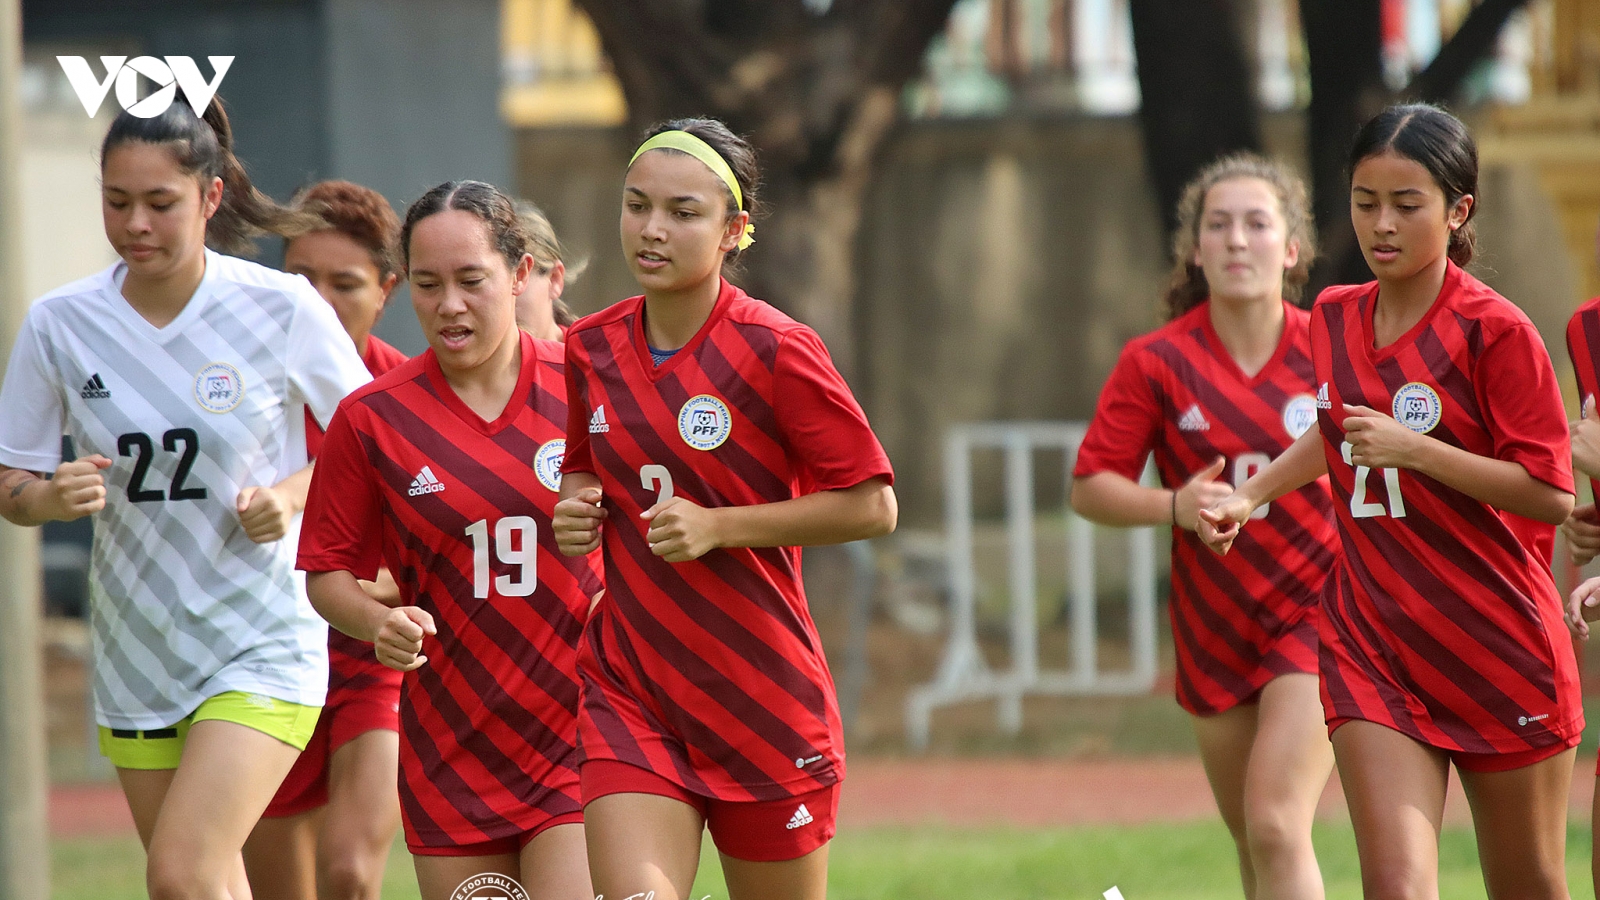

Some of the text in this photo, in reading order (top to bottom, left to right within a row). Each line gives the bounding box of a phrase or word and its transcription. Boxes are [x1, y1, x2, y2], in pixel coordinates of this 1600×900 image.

[81, 390, 111, 399] adidas
[208, 390, 233, 400] PFF
[688, 397, 719, 408] FOOTBALL
[1406, 412, 1429, 421] PFF
[692, 425, 719, 435] PFF
[118, 428, 207, 502] 22
[1341, 441, 1407, 518] 21
[408, 482, 445, 497] adidas
[465, 515, 538, 599] 19
[786, 815, 814, 829] adidas
